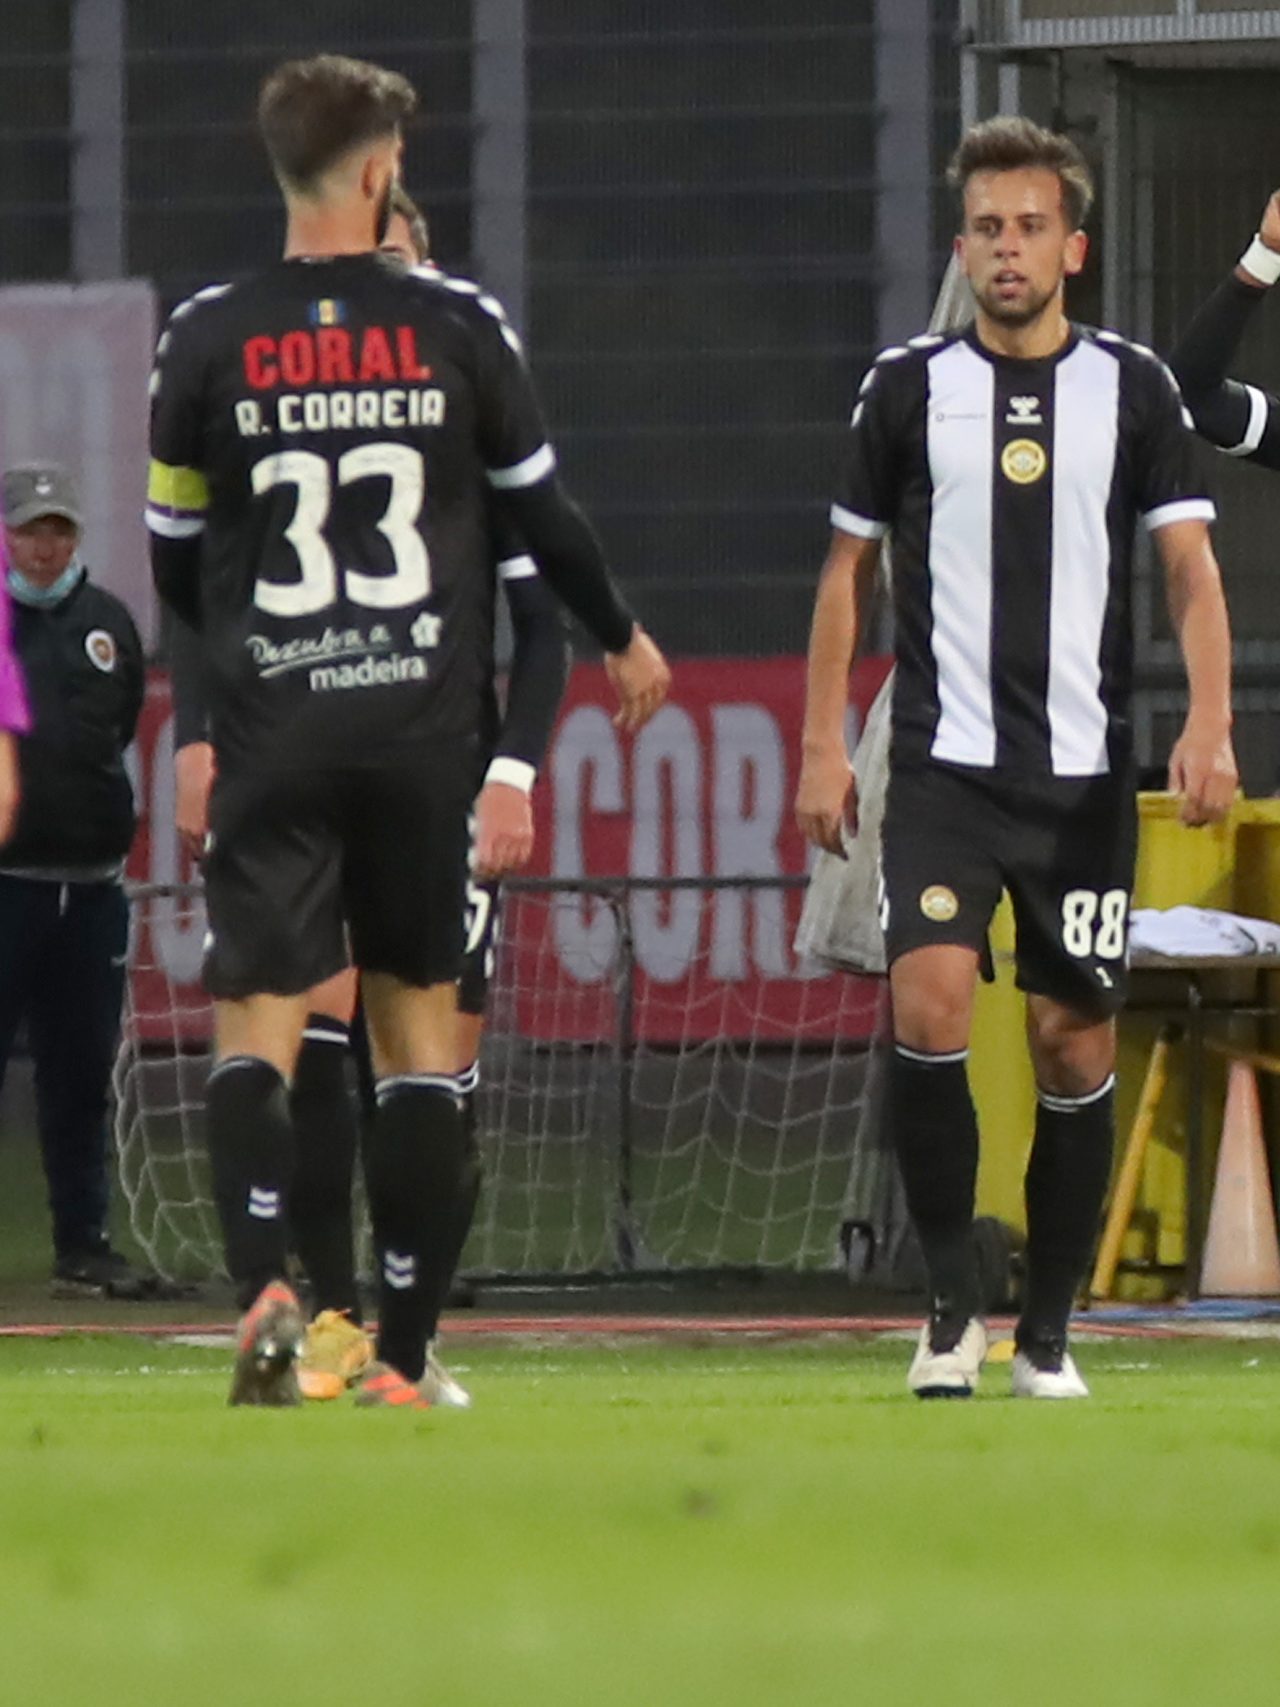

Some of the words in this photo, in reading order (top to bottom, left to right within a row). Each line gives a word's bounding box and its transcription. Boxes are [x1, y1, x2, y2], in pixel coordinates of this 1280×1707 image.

[243, 326, 431, 389] CORAL
[235, 399, 271, 436] R.
[277, 388, 446, 433] CORREIA
[251, 442, 432, 618] 33
[309, 653, 428, 691] madeira
[1062, 889, 1128, 959] 88
